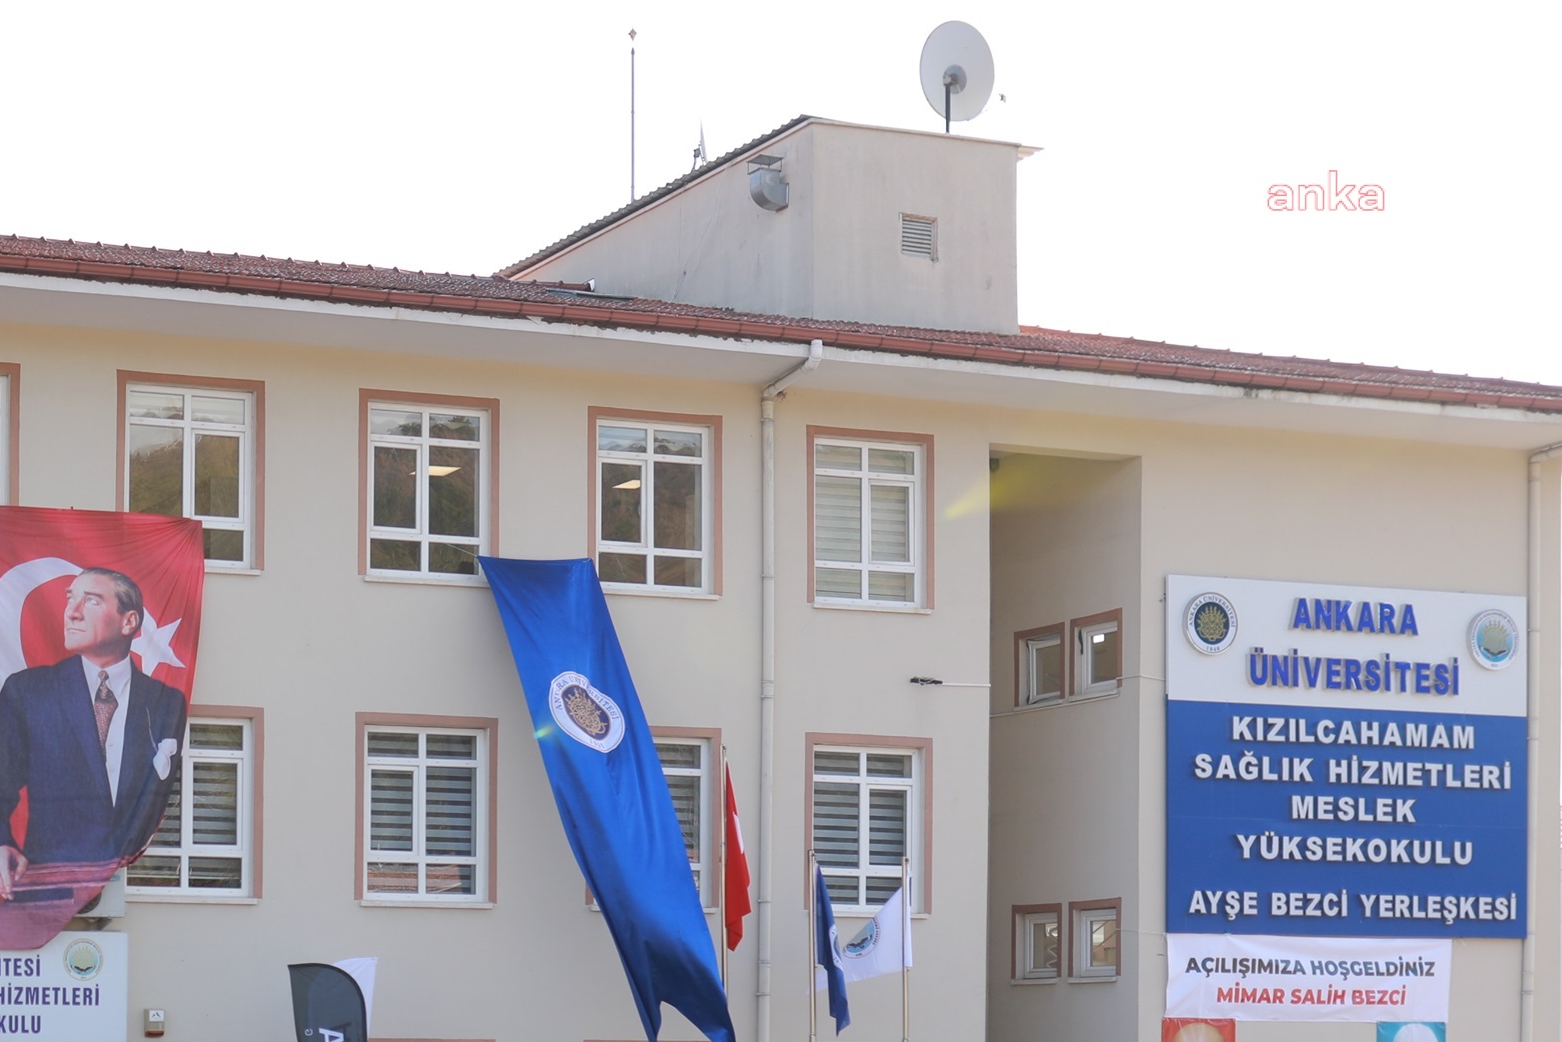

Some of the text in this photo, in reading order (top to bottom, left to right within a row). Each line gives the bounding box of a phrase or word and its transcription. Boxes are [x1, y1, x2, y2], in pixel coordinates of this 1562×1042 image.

[1292, 598, 1419, 636] ANKARA
[1249, 646, 1460, 695] ÜNİVERSİTESİ
[1232, 716, 1475, 750] KIZILCAHAMAM
[1194, 750, 1512, 790] SAĞLIK HİZMETLERİ
[1291, 795, 1417, 824] MESLEK
[1237, 831, 1474, 866] YÜKSEKOKULU
[1189, 889, 1518, 925] AYŞE BEZCİ YERLEŞKESİ
[1185, 956, 1436, 981] AÇILIŞIMIZA HOŞGELDİNİZ
[1216, 982, 1407, 1006] MİMAR SALİH BEZCİ
